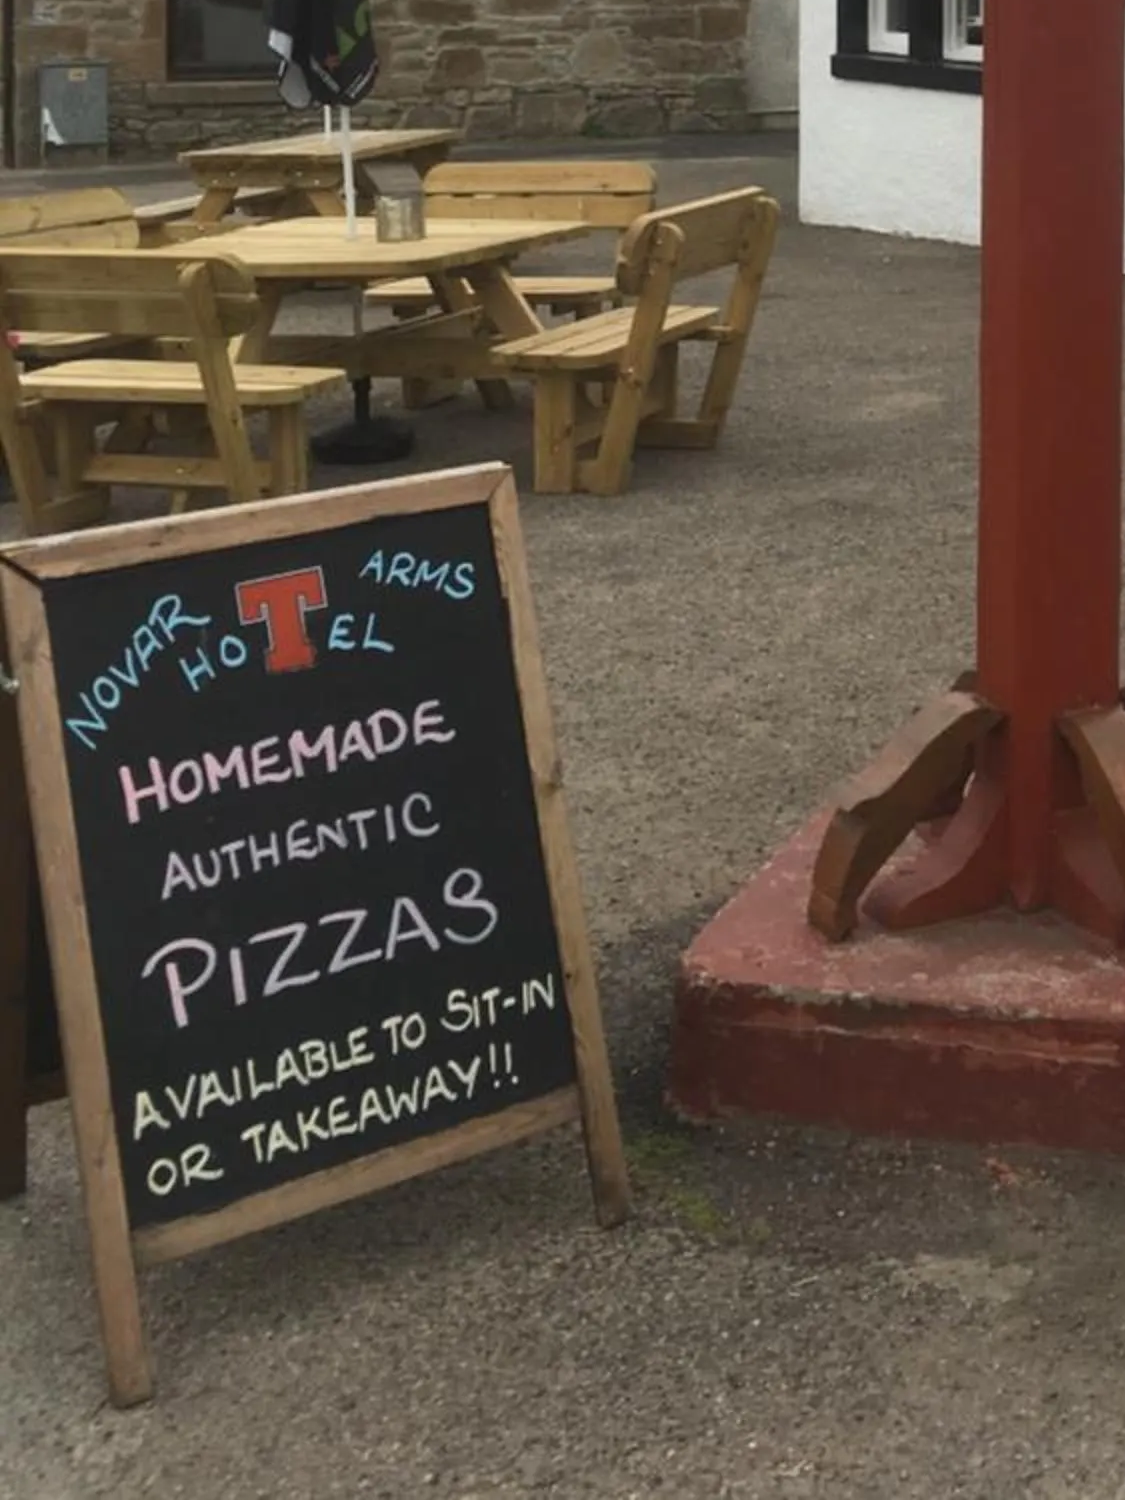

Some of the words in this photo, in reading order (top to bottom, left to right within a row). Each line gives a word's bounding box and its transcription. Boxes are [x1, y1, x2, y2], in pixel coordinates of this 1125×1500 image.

[65, 593, 212, 751] NOVAR
[358, 548, 478, 600] ARMS
[118, 699, 457, 826] HOMEMADE
[160, 792, 442, 900] AUTHENTIC
[141, 866, 500, 1029] PIZZAS
[132, 1033, 376, 1142] AVAILABLE
[380, 1012, 428, 1055] TO
[146, 1141, 224, 1197] OR
[240, 1041, 521, 1167] TAKEAWAY!!
